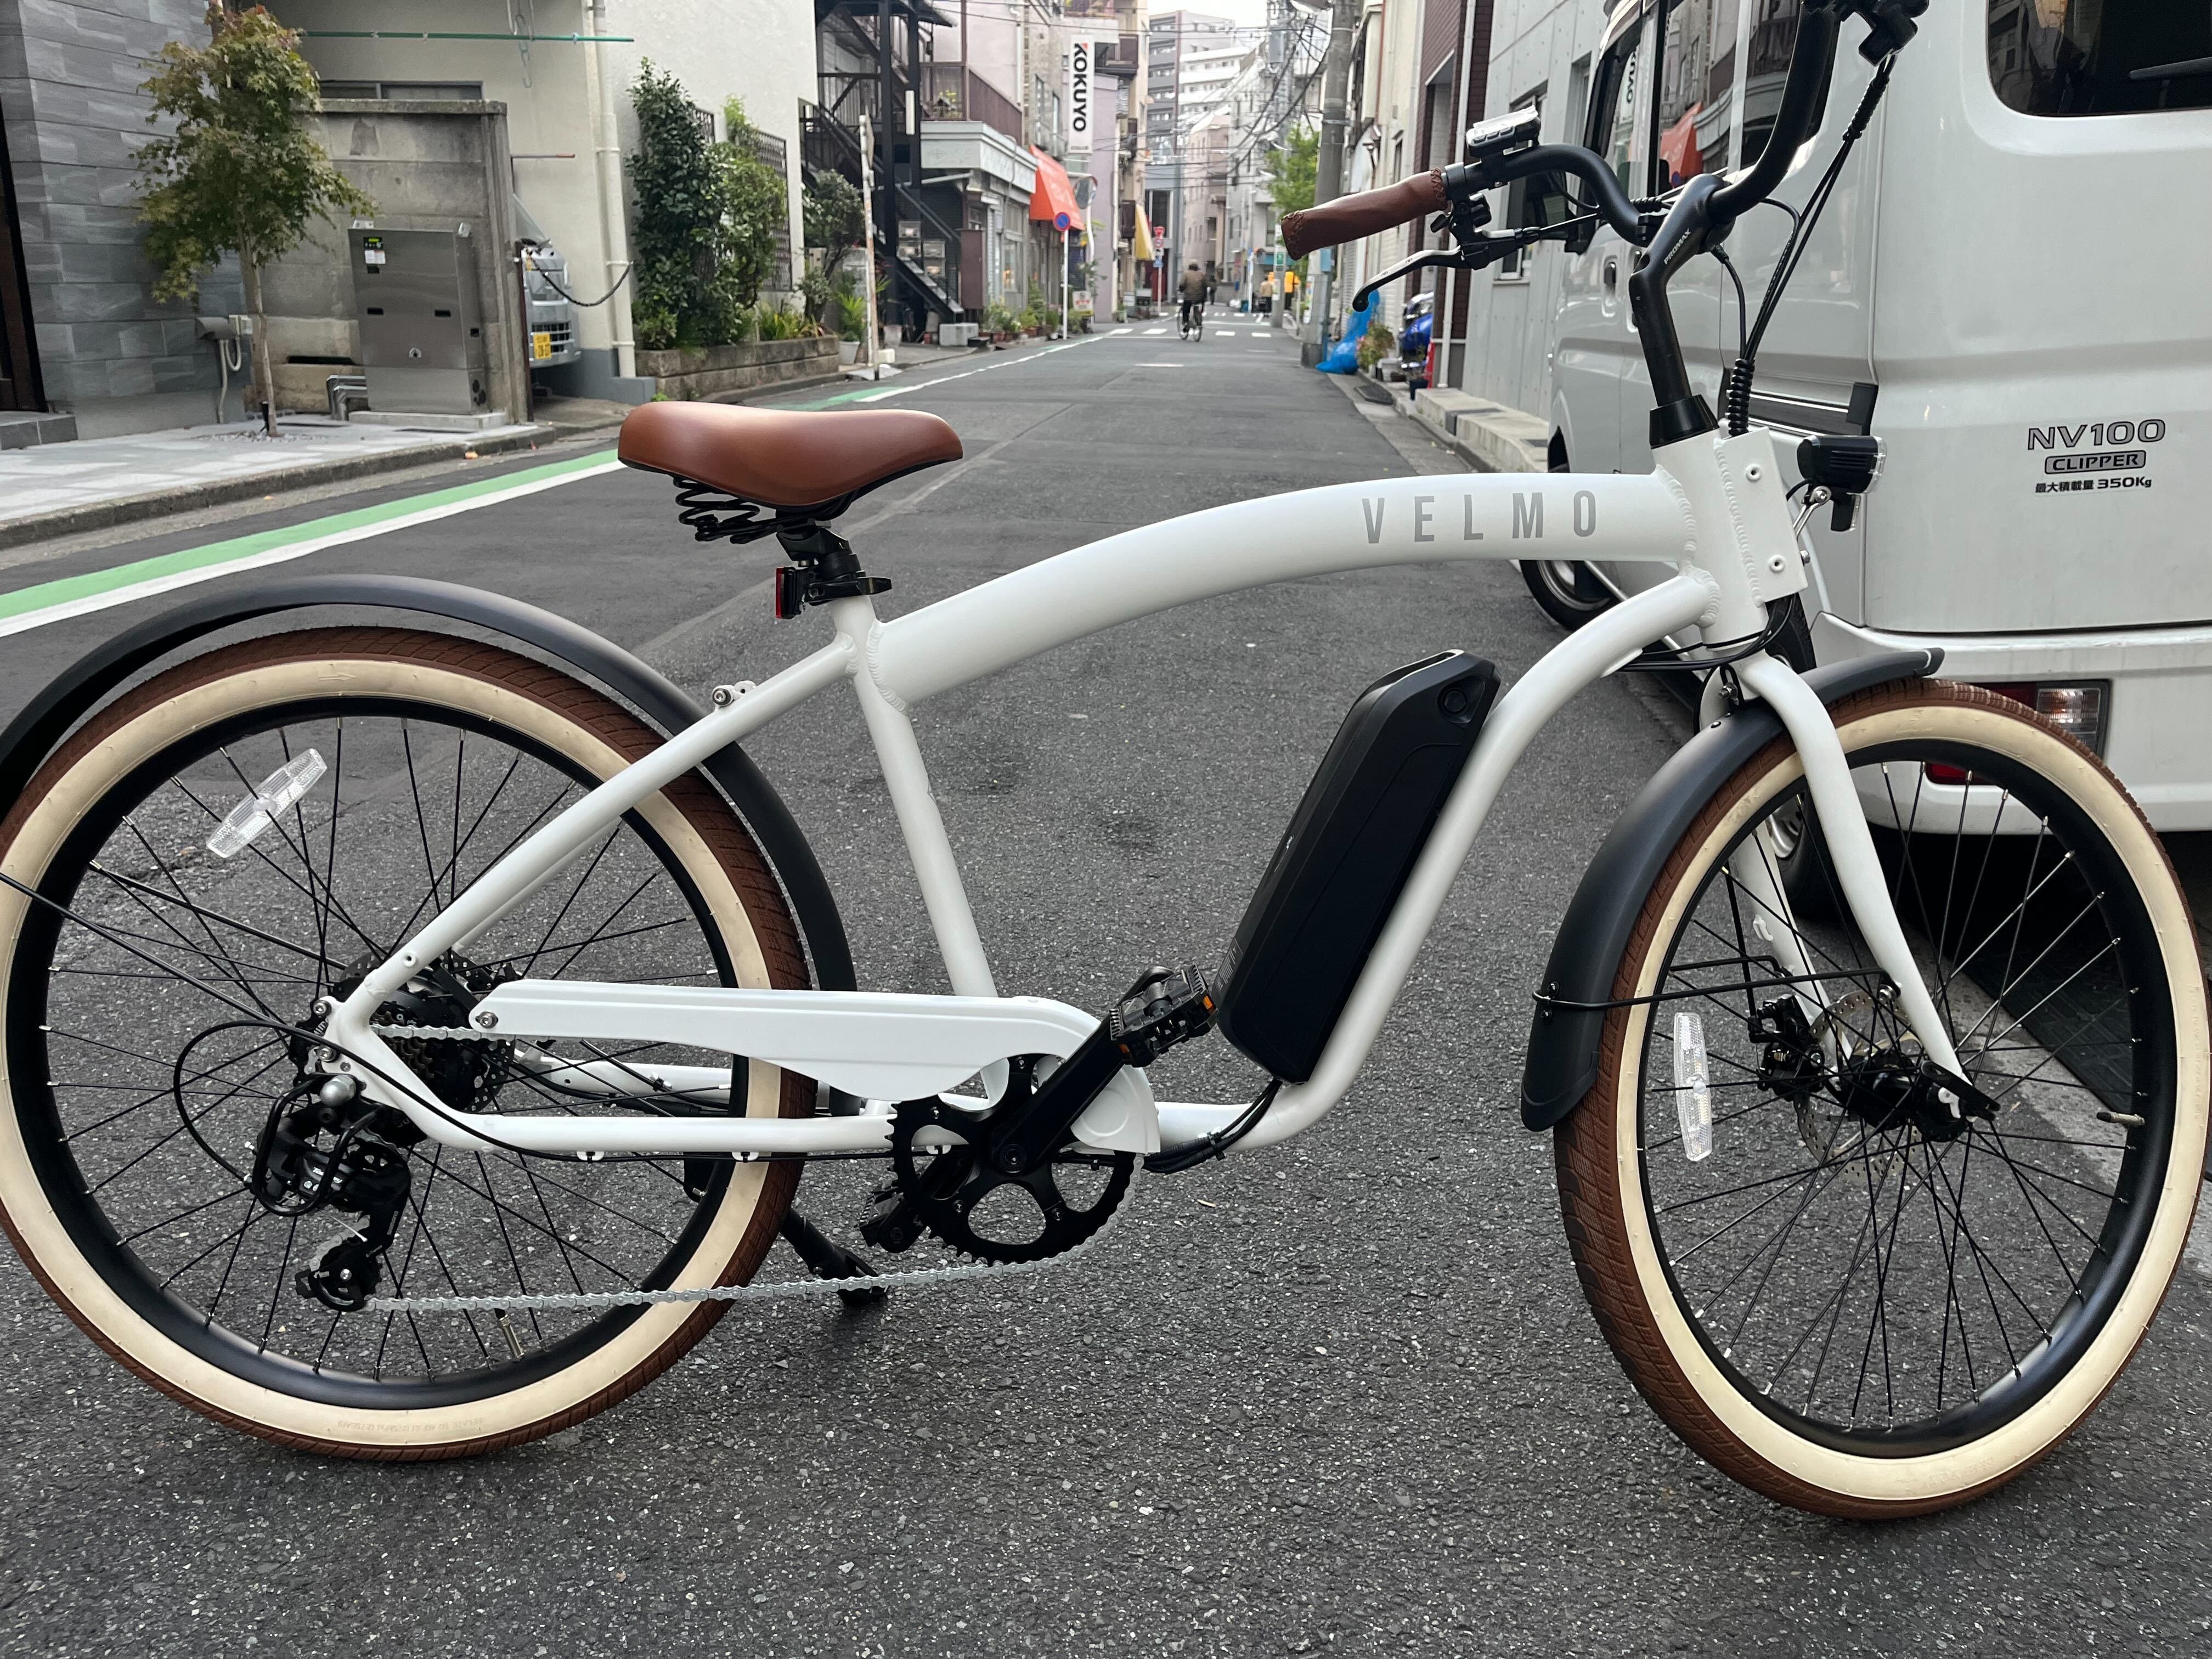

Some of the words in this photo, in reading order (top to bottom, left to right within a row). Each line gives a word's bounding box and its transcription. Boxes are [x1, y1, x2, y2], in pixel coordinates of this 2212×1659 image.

[1073, 43, 1088, 132] KOKUYO
[1663, 228, 1691, 265] PROMAX
[2028, 419, 2166, 450] NV100
[2052, 454, 2138, 471] CLIPPER
[2035, 479, 2094, 493] 最大積載量
[2097, 476, 2152, 489] 350Kg
[1362, 490, 1596, 544] VELMO
